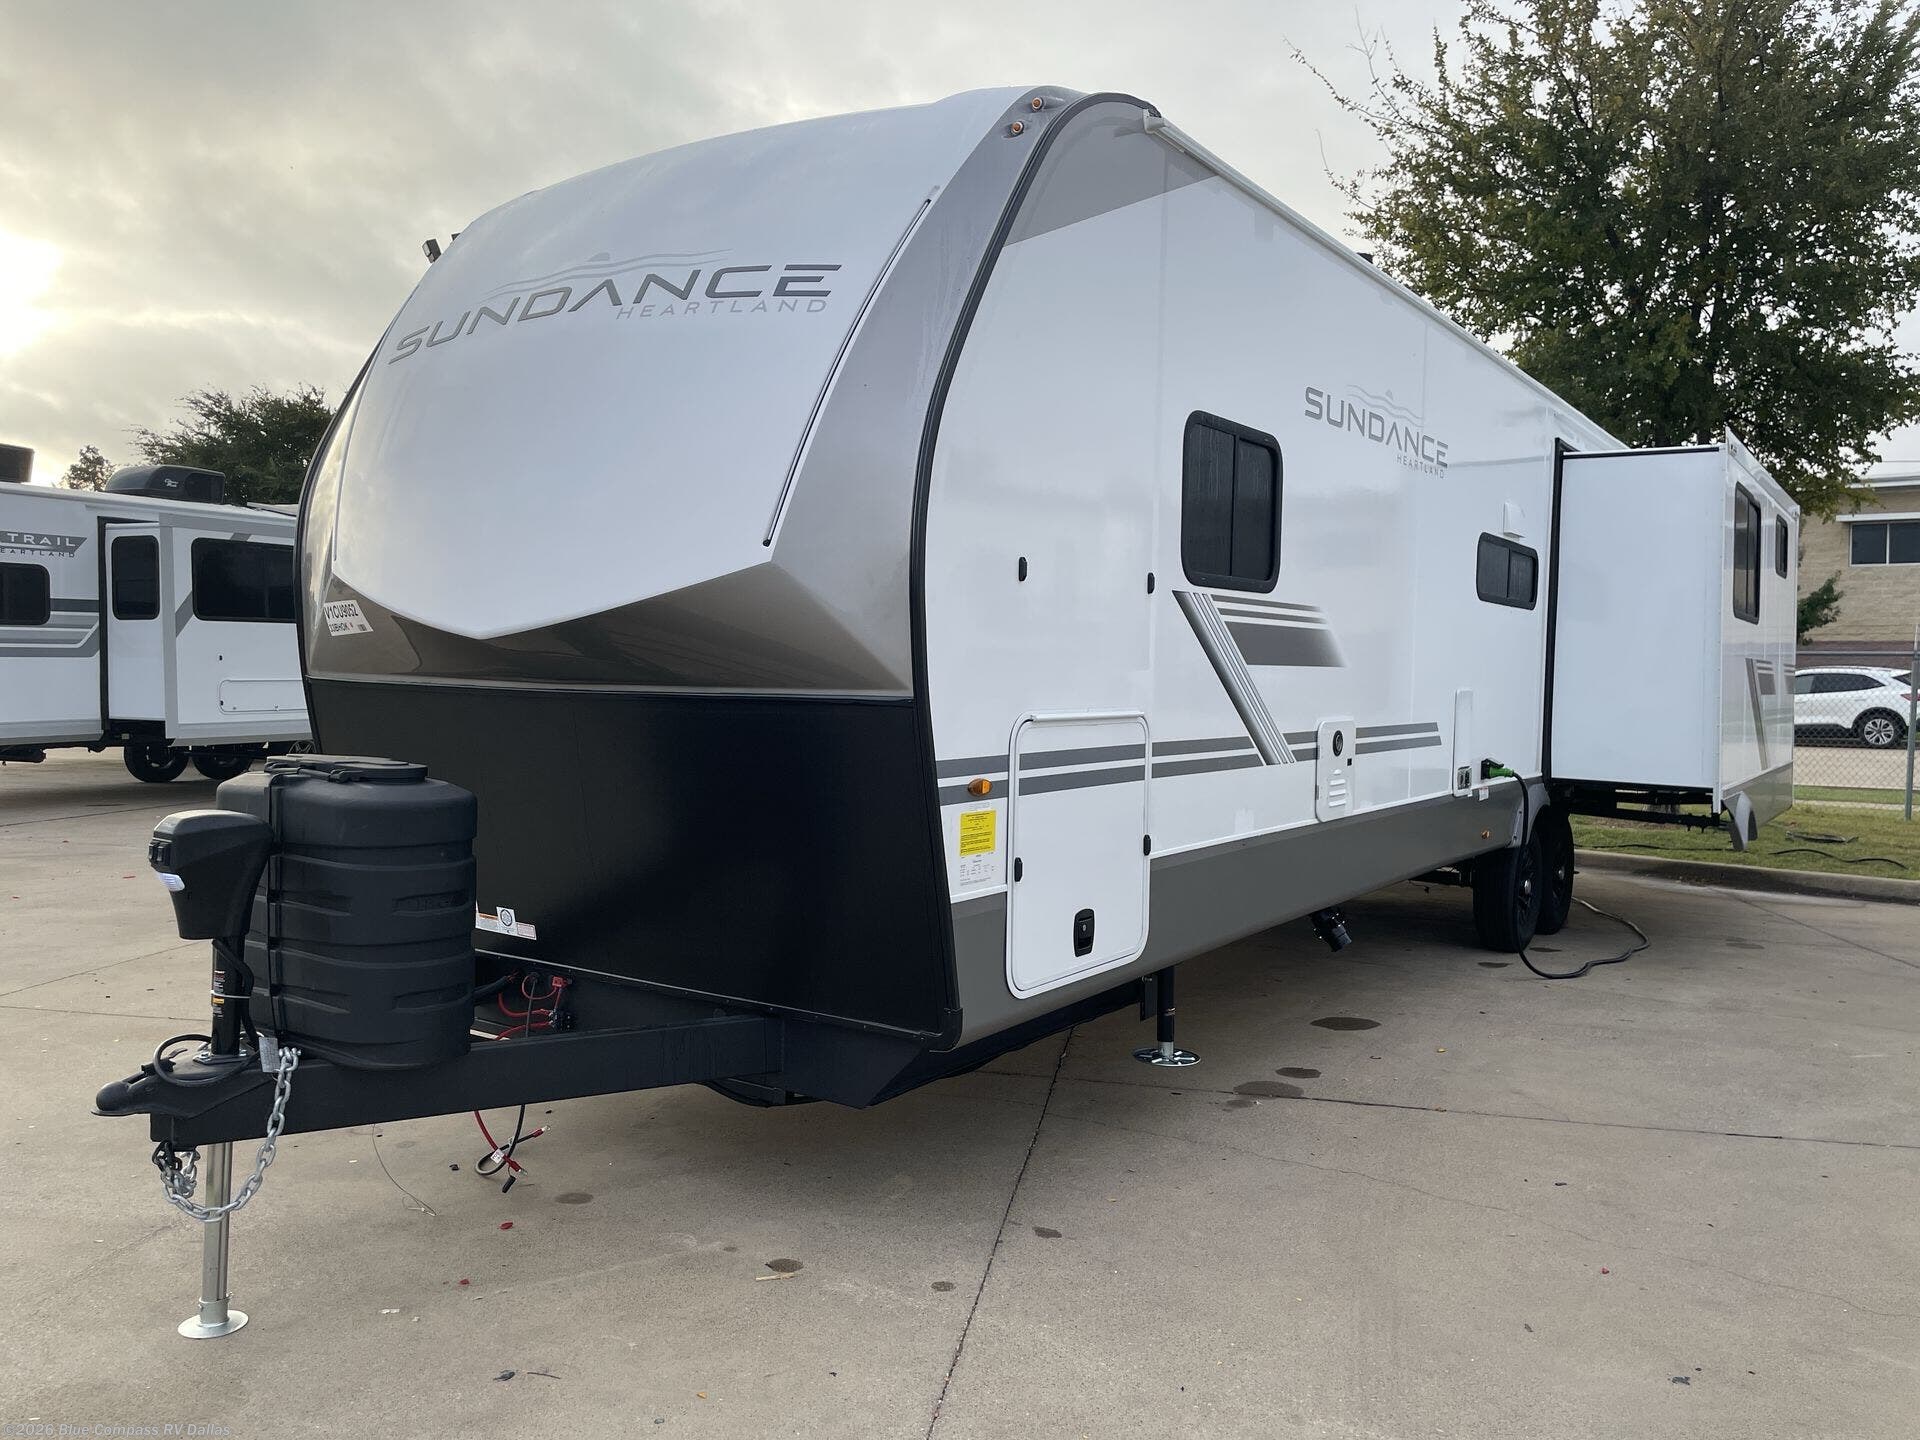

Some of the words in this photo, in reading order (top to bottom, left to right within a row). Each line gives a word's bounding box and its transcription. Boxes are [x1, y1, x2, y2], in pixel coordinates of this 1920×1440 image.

[388, 264, 842, 364] SUNDANCE
[616, 299, 827, 320] HEARTLAND
[1304, 386, 1449, 469] SUNDANCE
[1396, 455, 1445, 479] HEARTLAND
[7, 533, 76, 547] TRAIL
[0, 547, 75, 558] EARTLAND
